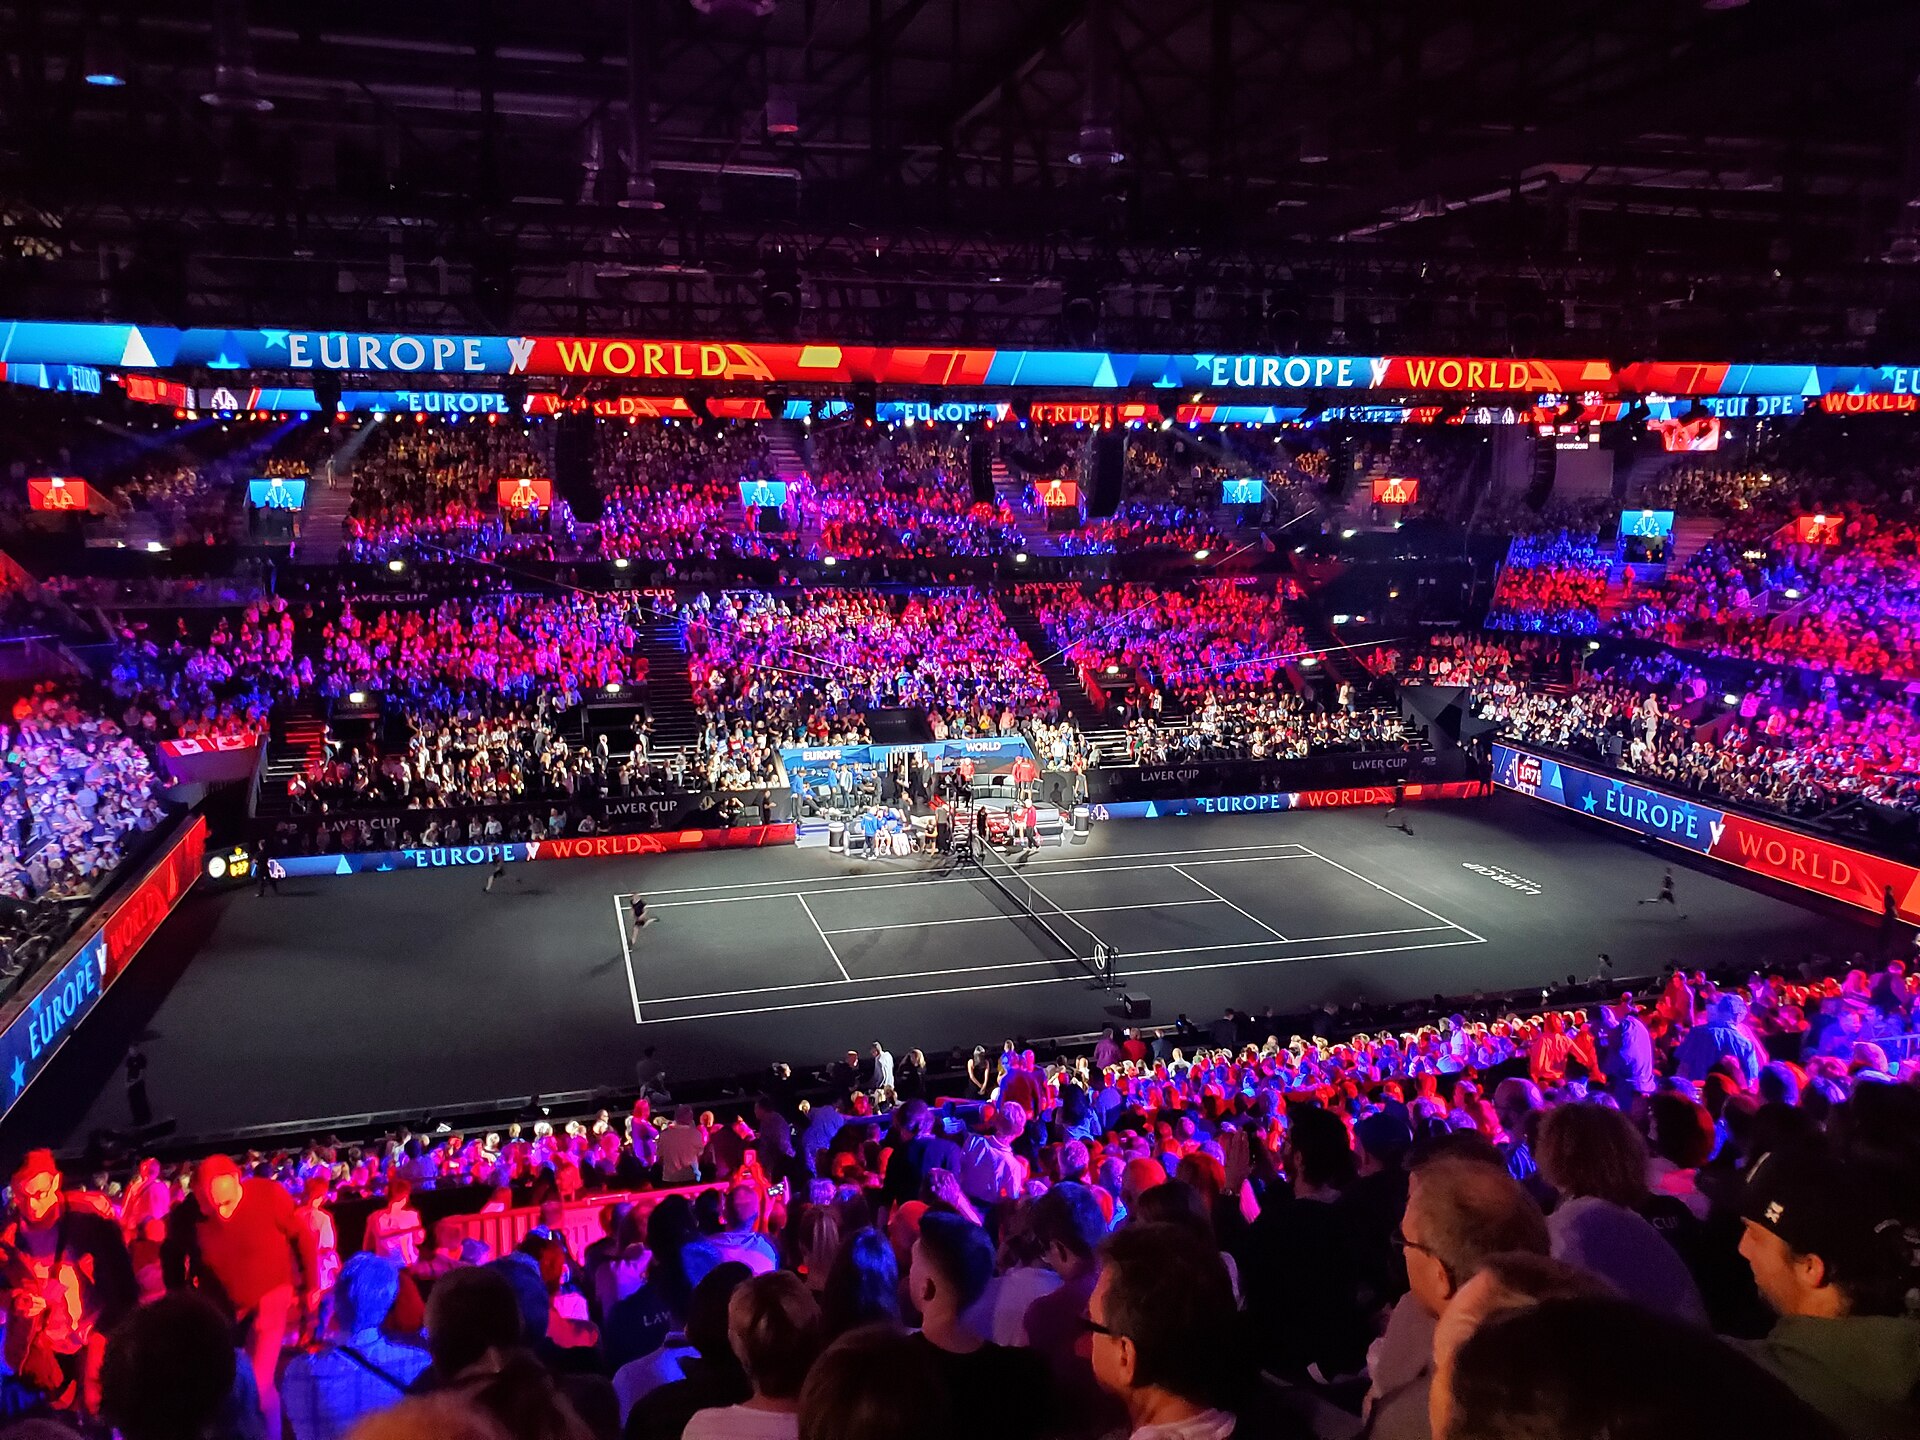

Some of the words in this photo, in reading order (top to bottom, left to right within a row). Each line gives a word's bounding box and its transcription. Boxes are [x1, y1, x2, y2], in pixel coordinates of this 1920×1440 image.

[289, 334, 486, 371] EUROPE
[555, 340, 729, 378] WORLD
[1211, 357, 1355, 388] EUROPE
[1405, 360, 1529, 390] WORLD
[410, 393, 510, 413] EUROPE
[643, 588, 676, 600] CUP
[802, 749, 843, 761] EUROPE
[965, 741, 1002, 752] WORLD
[1353, 759, 1384, 770] LAVER
[1385, 758, 1408, 769] CUP
[1141, 771, 1174, 783] LAVER
[1176, 769, 1200, 781] CUP
[605, 802, 647, 815] LAVER
[649, 800, 678, 813] CUP
[1204, 794, 1281, 813] EUROPE
[1308, 789, 1376, 807] WORLD
[1604, 790, 1700, 840] EUROPE
[1738, 830, 1852, 886] WORLD
[415, 844, 516, 869] EUROPE
[551, 836, 642, 859] WORLD
[29, 959, 96, 1060] EUROPE
